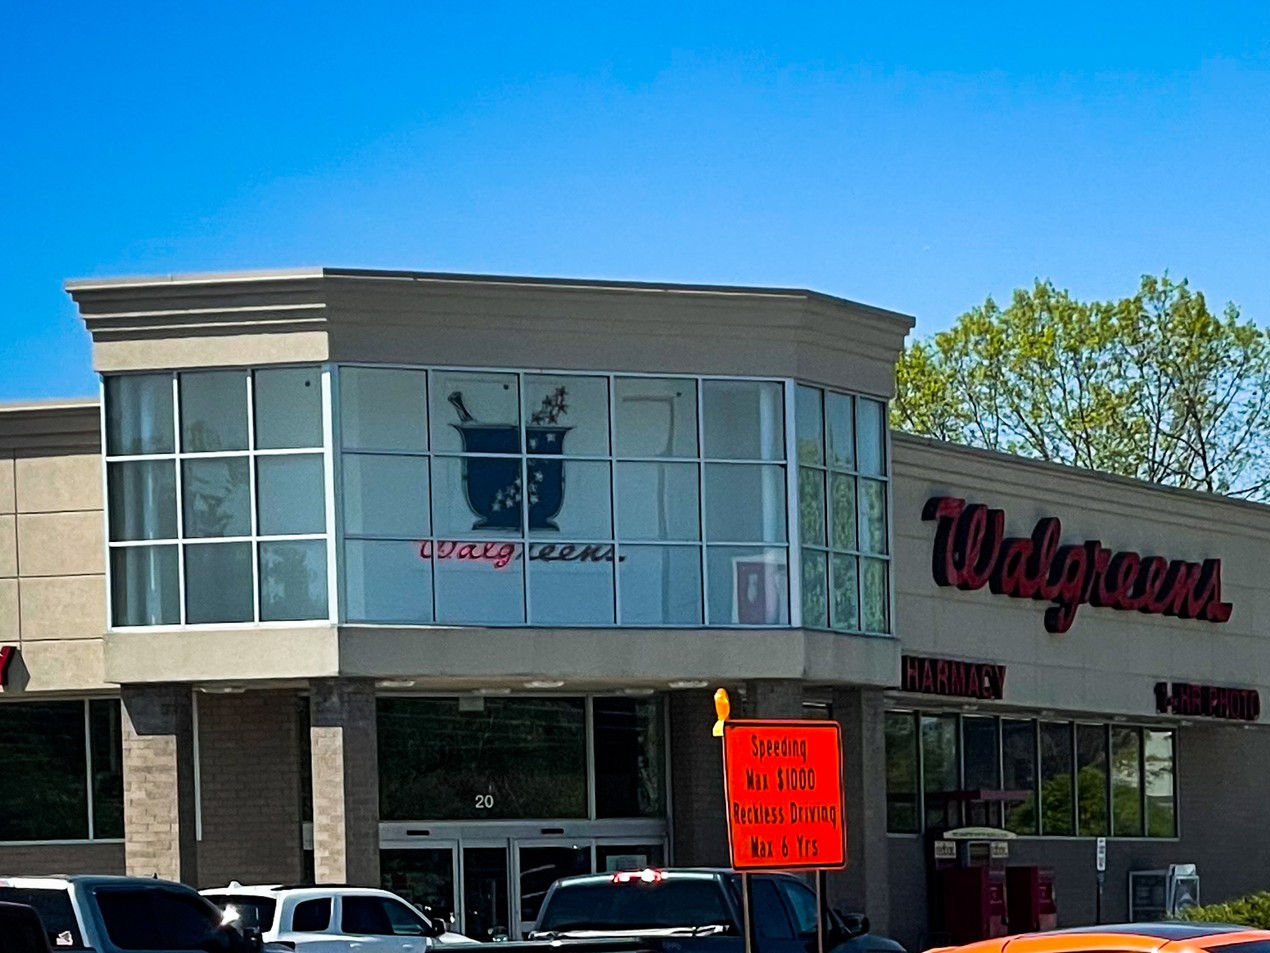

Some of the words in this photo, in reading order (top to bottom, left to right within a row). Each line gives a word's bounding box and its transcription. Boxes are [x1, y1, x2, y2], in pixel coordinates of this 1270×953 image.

[417, 540, 626, 568] Walgreens
[922, 496, 1233, 634] Walgreens
[1208, 686, 1261, 721] PHOTO
[751, 734, 807, 763] Speeding
[746, 768, 768, 790] Max
[777, 767, 815, 791] $1000
[475, 794, 494, 808] 20
[733, 802, 784, 824] Reckless
[790, 802, 836, 829] Driving
[751, 835, 773, 858] Max
[782, 836, 789, 857] 6
[797, 835, 818, 857] Yrs
